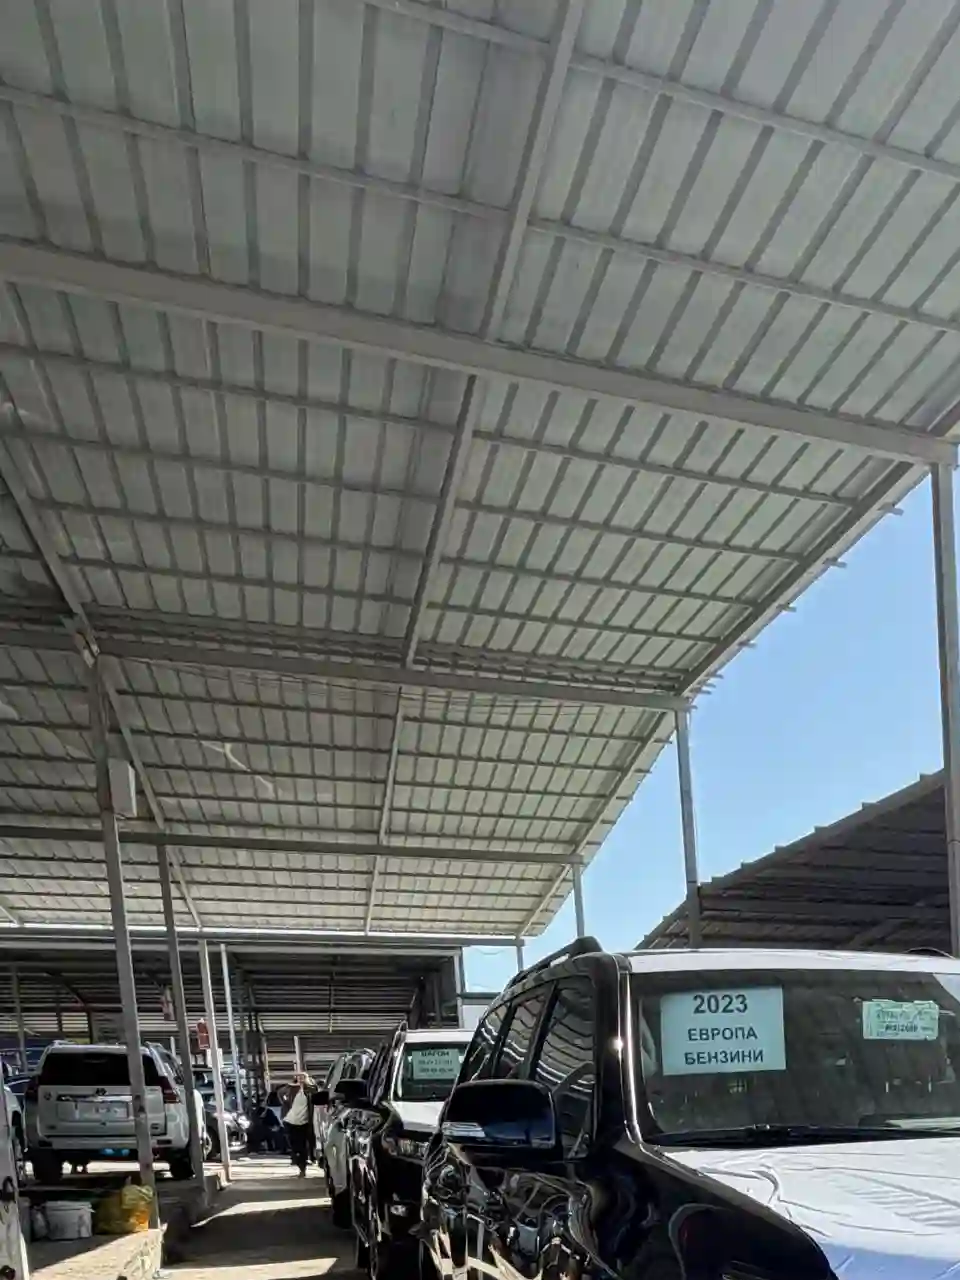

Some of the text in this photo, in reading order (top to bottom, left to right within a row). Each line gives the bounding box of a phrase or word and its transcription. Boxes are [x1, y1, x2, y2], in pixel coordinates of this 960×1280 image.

[693, 994, 748, 1014] 2023
[687, 1026, 758, 1041] ЕВРОПА
[684, 1049, 764, 1065] БЕНЗИНИ
